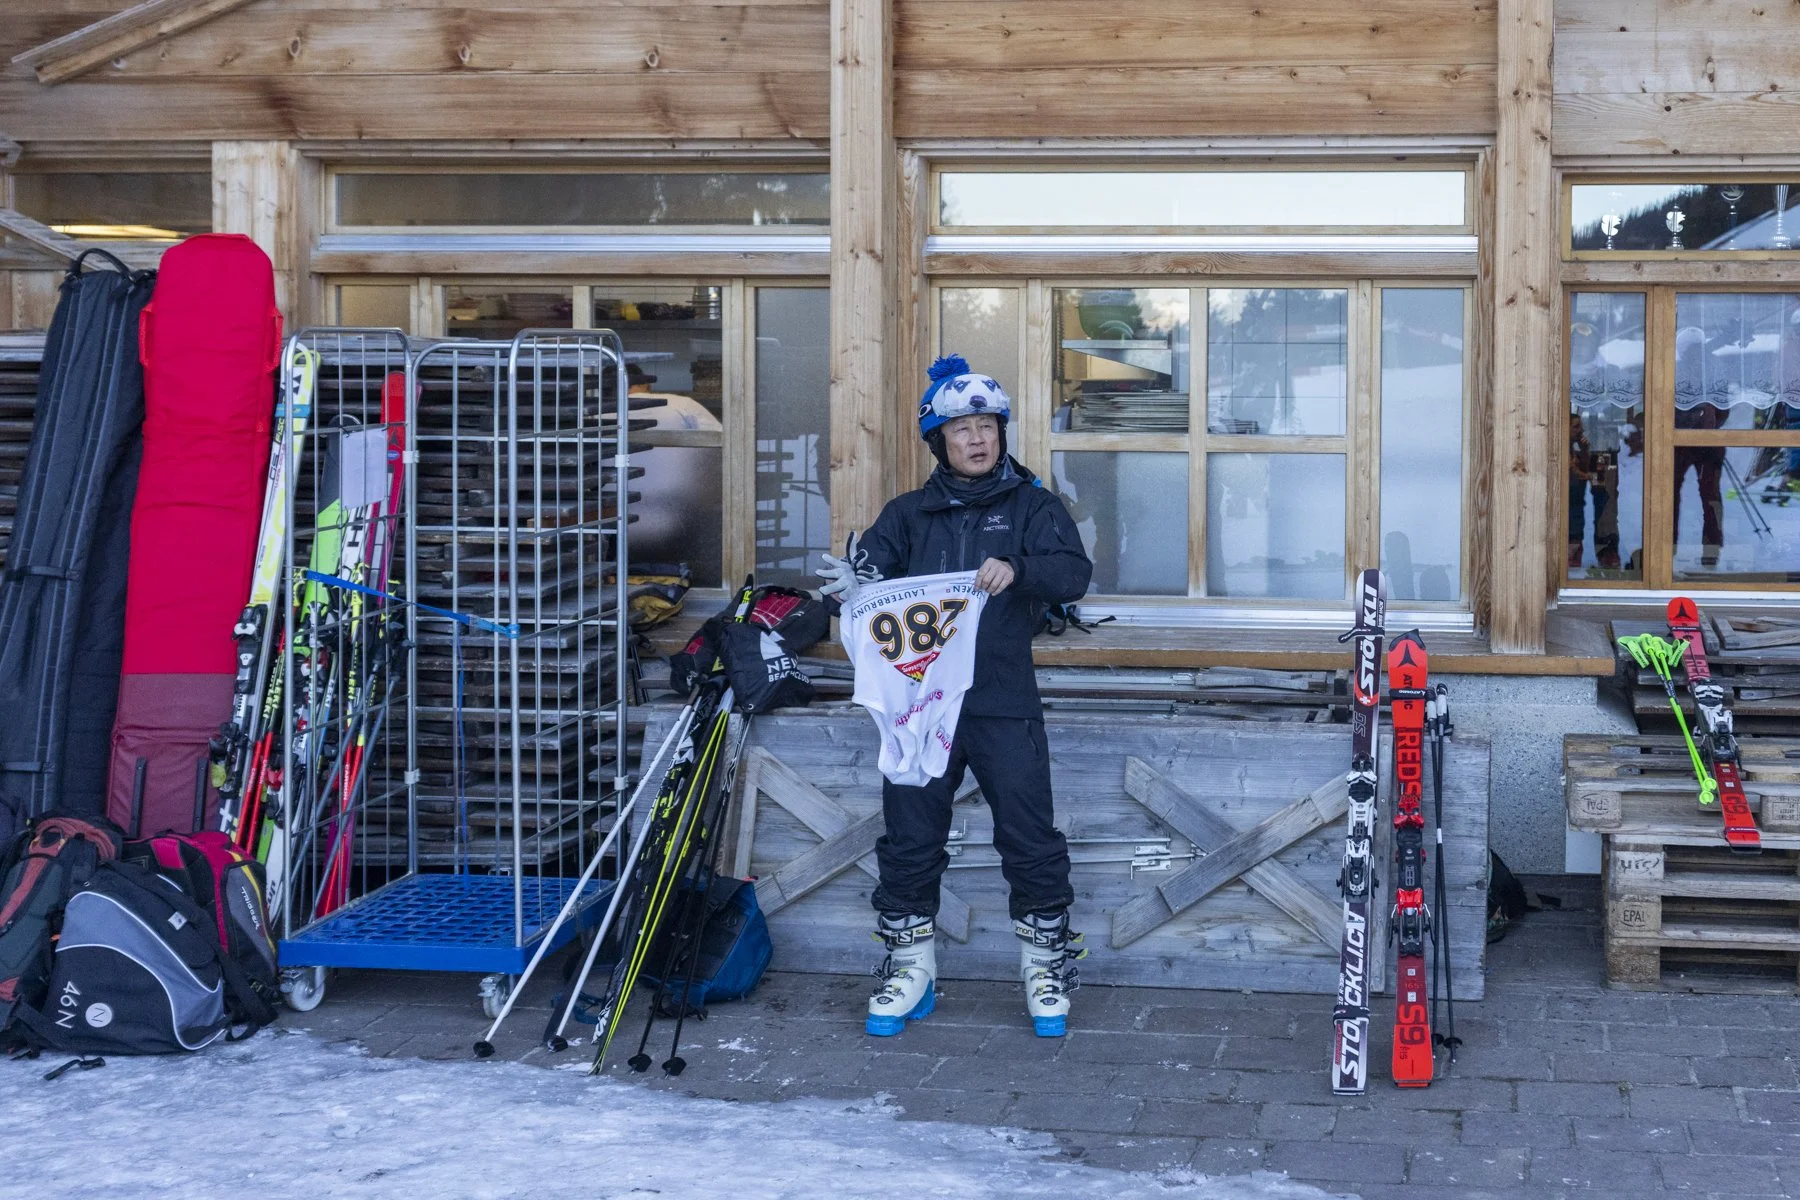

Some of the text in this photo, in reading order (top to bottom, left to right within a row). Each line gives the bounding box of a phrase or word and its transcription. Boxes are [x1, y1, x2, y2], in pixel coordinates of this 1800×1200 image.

[870, 599, 968, 662] 286
[263, 687, 273, 719] LEKI
[272, 678, 282, 709] LEKI
[1403, 674, 1413, 710] ATIC
[1353, 711, 1366, 737] SG
[54, 980, 81, 1029] 46N
[1341, 913, 1366, 1080] STOCKLI.CH
[1400, 1003, 1426, 1047] S9
